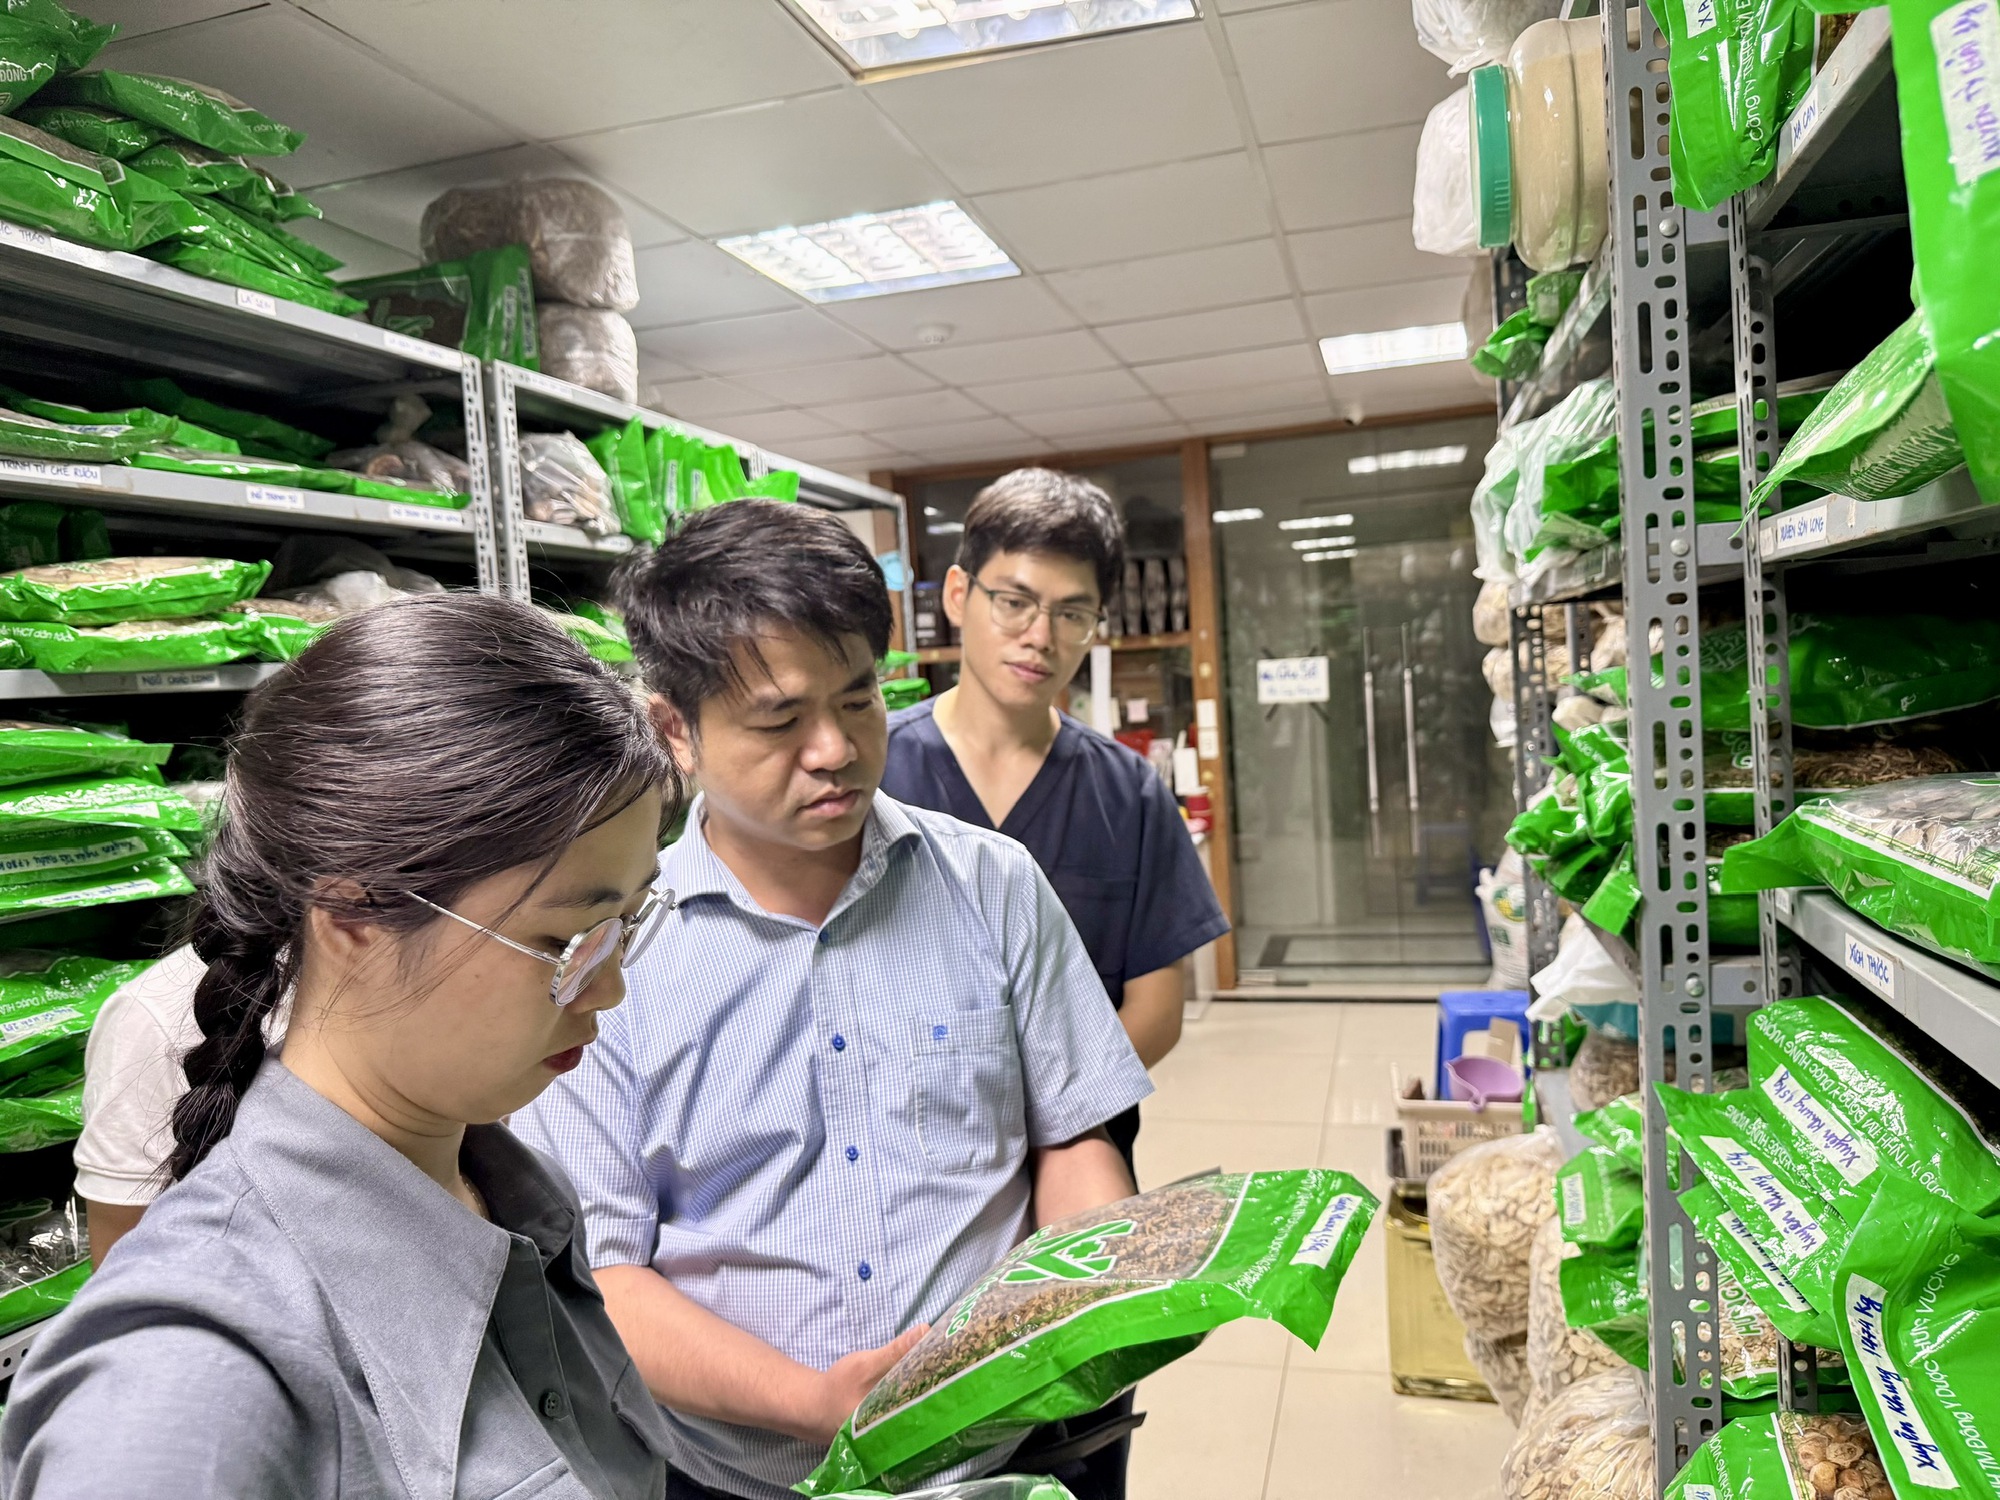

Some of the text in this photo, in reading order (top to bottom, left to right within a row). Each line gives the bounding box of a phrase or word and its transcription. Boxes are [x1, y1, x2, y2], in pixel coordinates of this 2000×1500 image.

[1915, 1252, 1960, 1314] VƯỢNG
[1875, 1365, 1908, 1417] Khung
[1924, 1359, 1956, 1398] Dược
[1893, 1420, 1942, 1472] Xuyên
[1952, 1410, 1989, 1454] Đông
